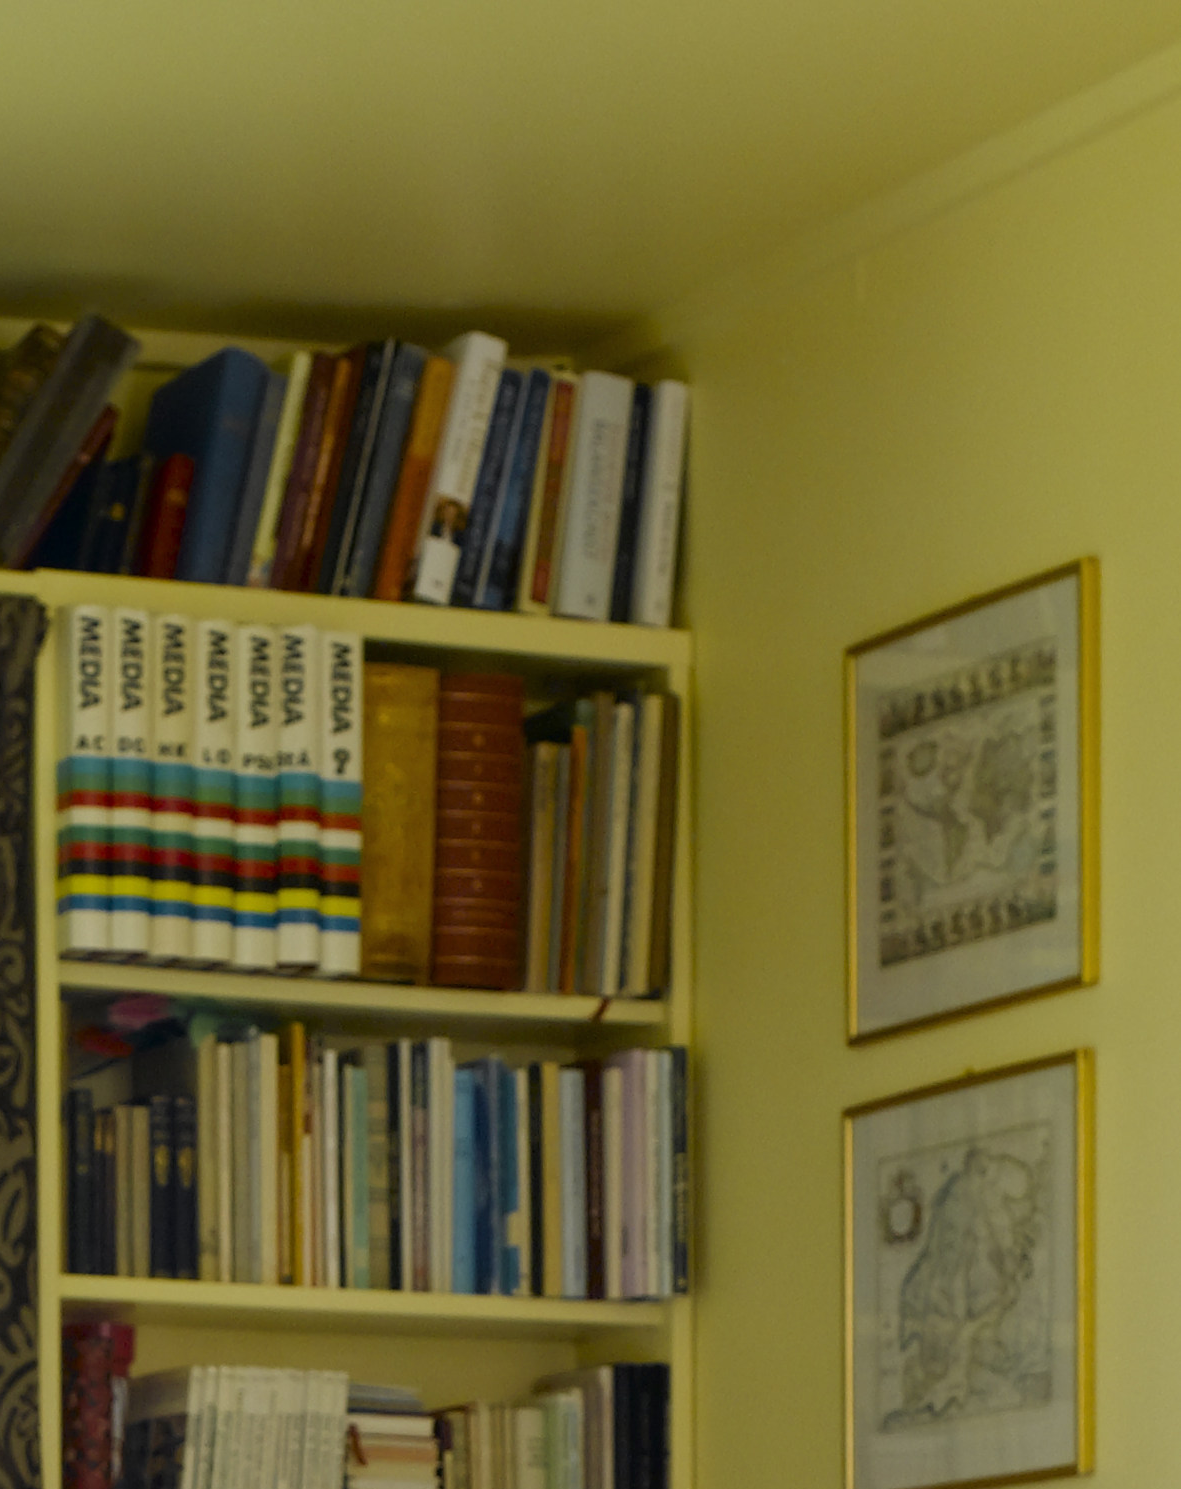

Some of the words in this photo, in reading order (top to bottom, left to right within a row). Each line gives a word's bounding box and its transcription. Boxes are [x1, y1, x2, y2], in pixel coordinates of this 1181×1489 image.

[79, 616, 102, 709] MEDIA
[121, 619, 143, 711] MEDIA
[163, 623, 185, 715] MEDIA
[208, 630, 229, 722] MEDIA
[250, 636, 271, 728] MEDIA
[282, 635, 304, 726] MEDIA
[331, 642, 353, 734] MEDIA
